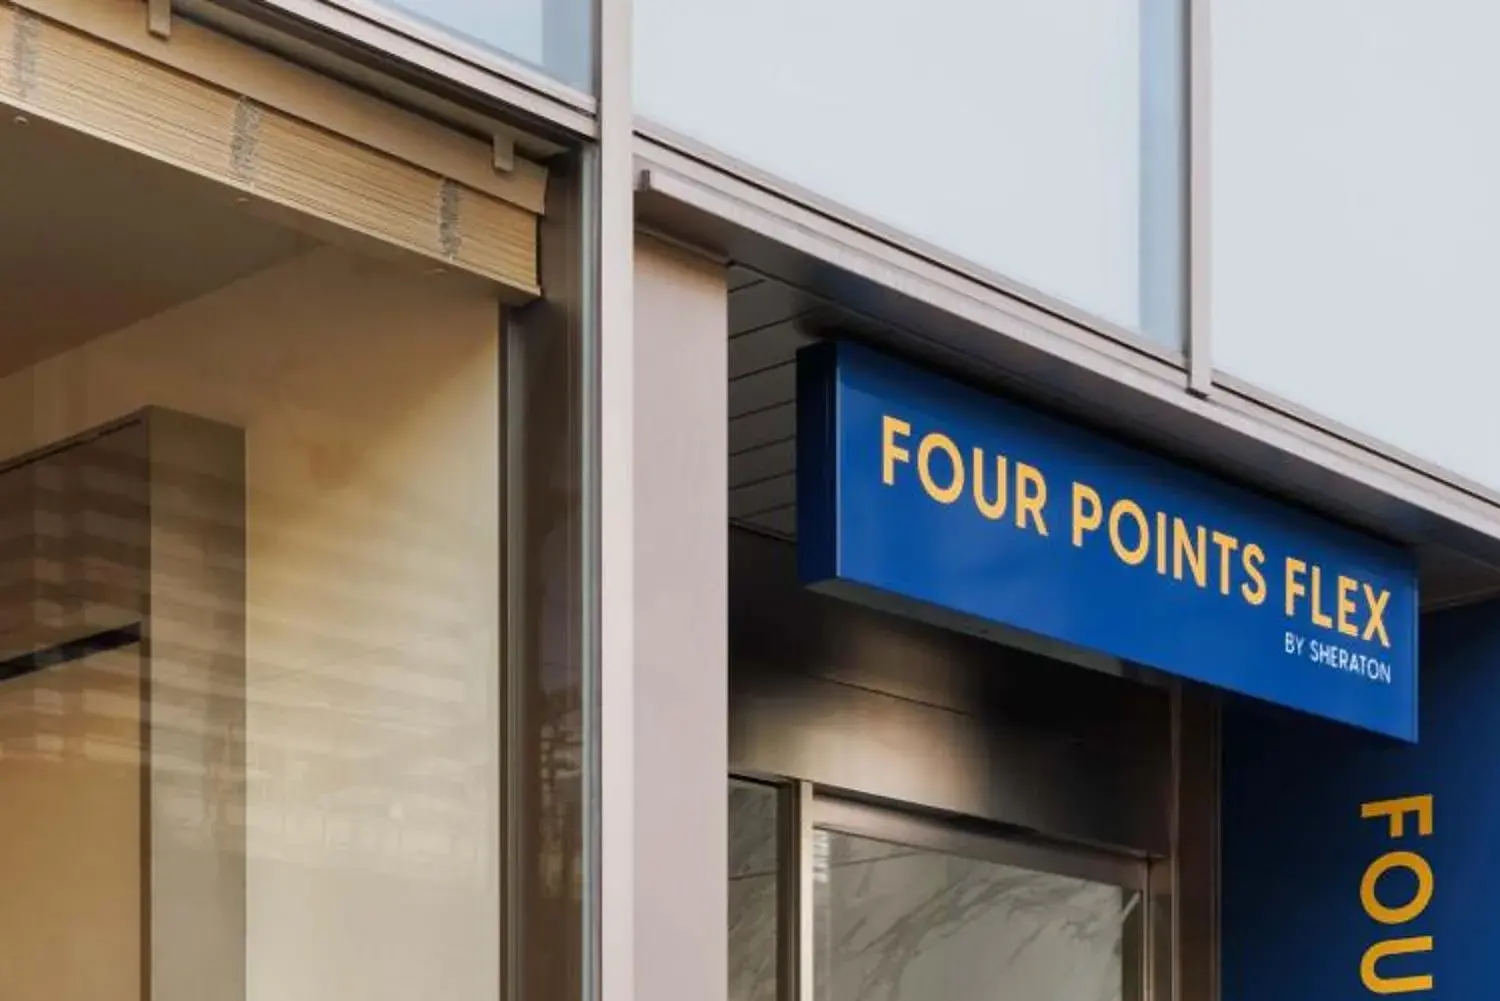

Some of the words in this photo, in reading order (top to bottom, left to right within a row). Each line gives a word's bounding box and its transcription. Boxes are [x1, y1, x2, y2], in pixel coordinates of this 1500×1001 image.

[881, 415, 1048, 536] FOUR
[1071, 482, 1267, 605] POINTS
[1284, 556, 1391, 648] FLEX
[1284, 631, 1304, 656] BY
[1309, 639, 1391, 684] SHERATON
